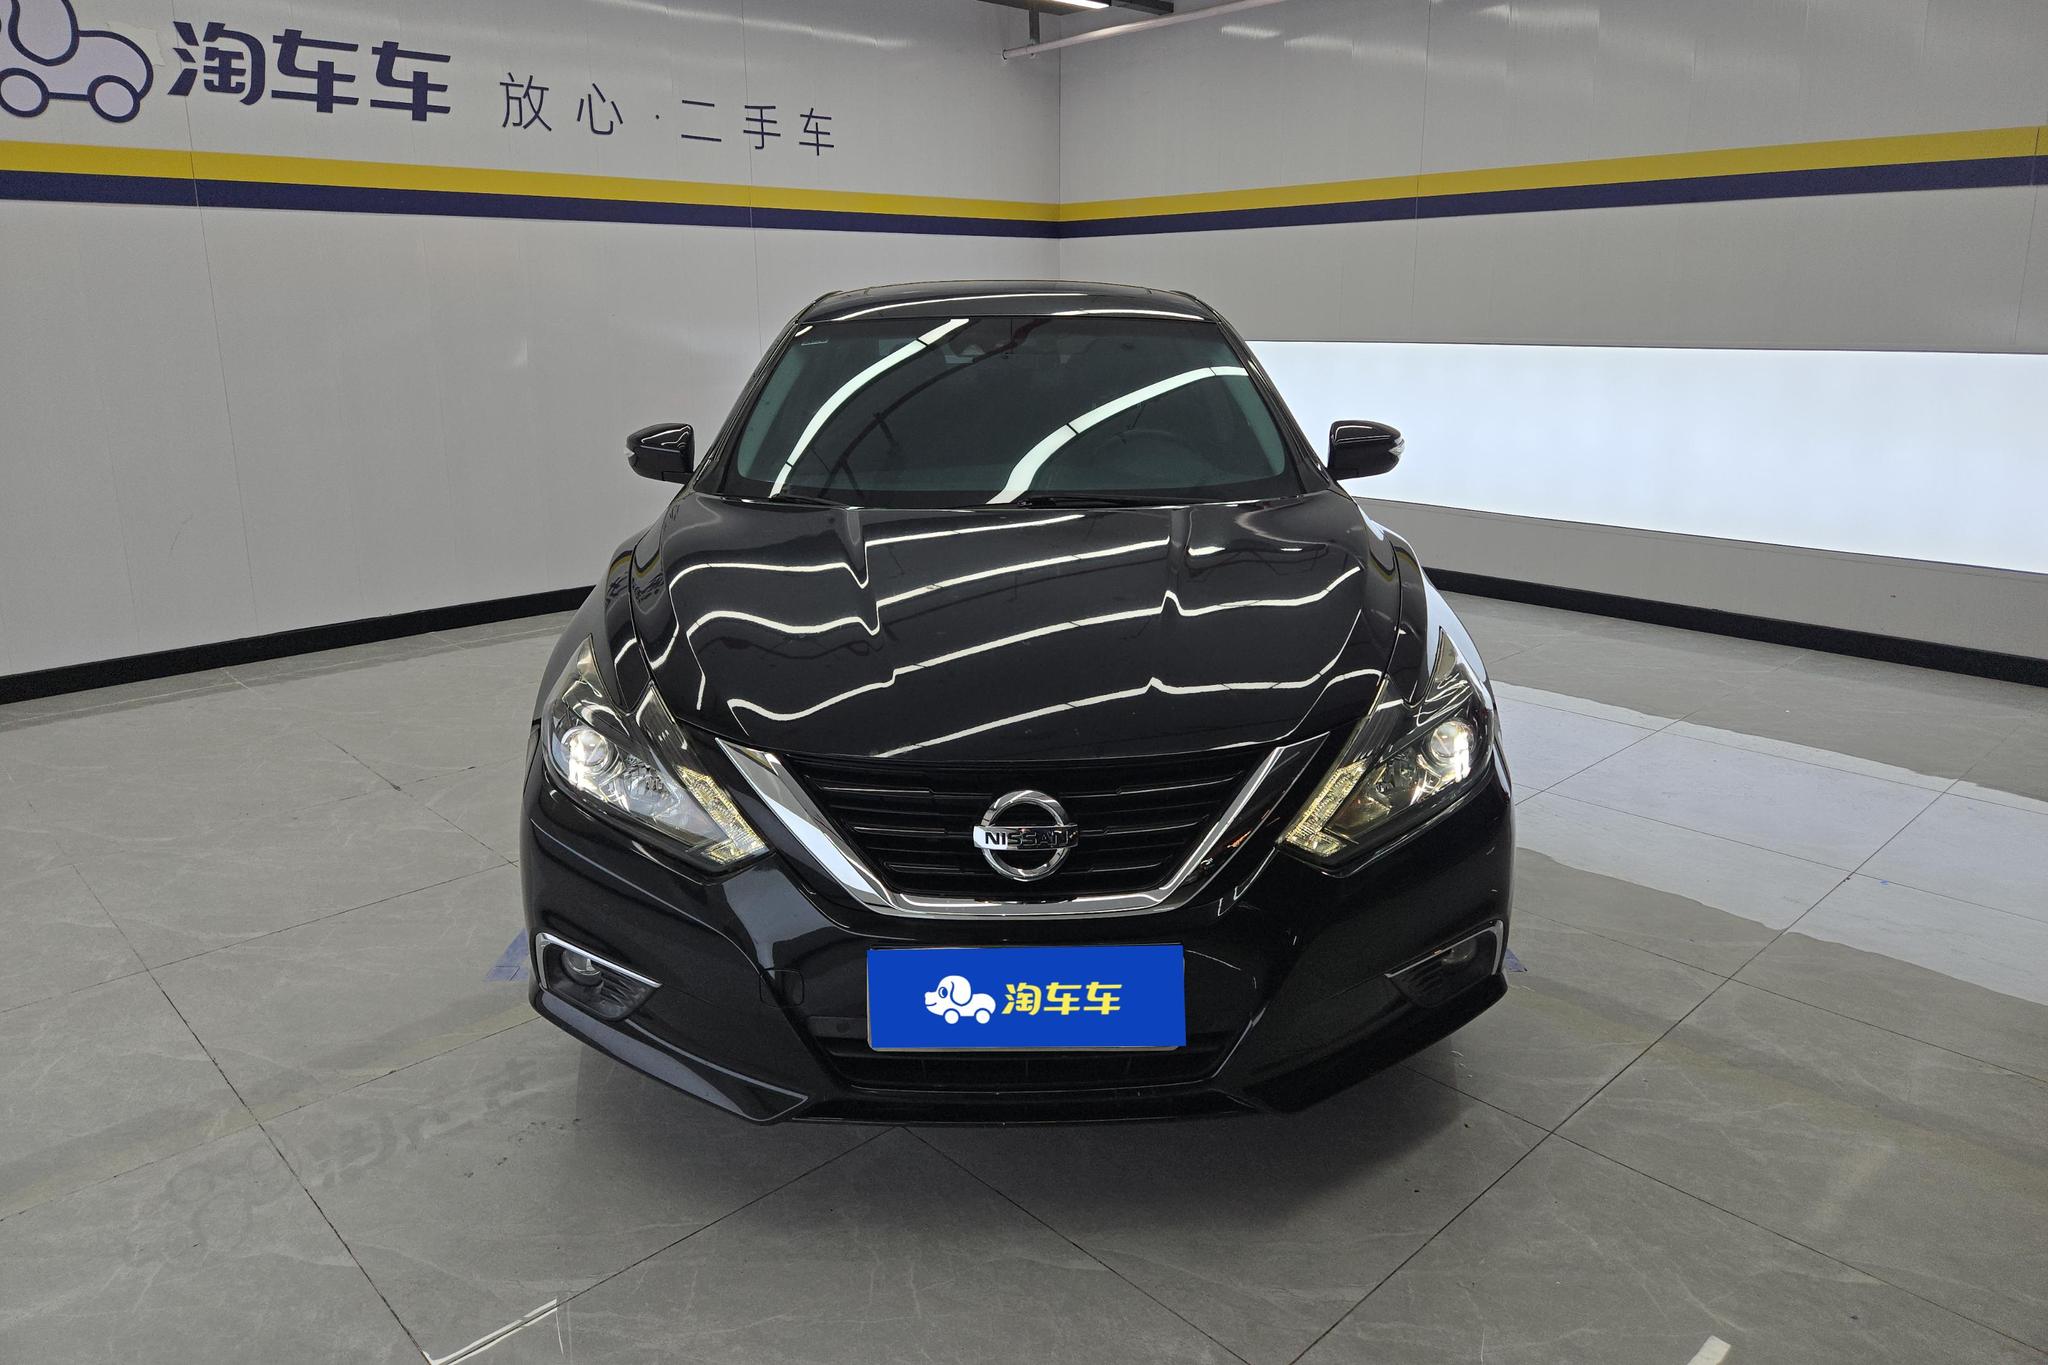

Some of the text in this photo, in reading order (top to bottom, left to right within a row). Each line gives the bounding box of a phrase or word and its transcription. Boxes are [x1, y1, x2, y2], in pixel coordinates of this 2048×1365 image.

[167, 20, 451, 122] 淘车车
[984, 831, 1069, 848] NISSAN
